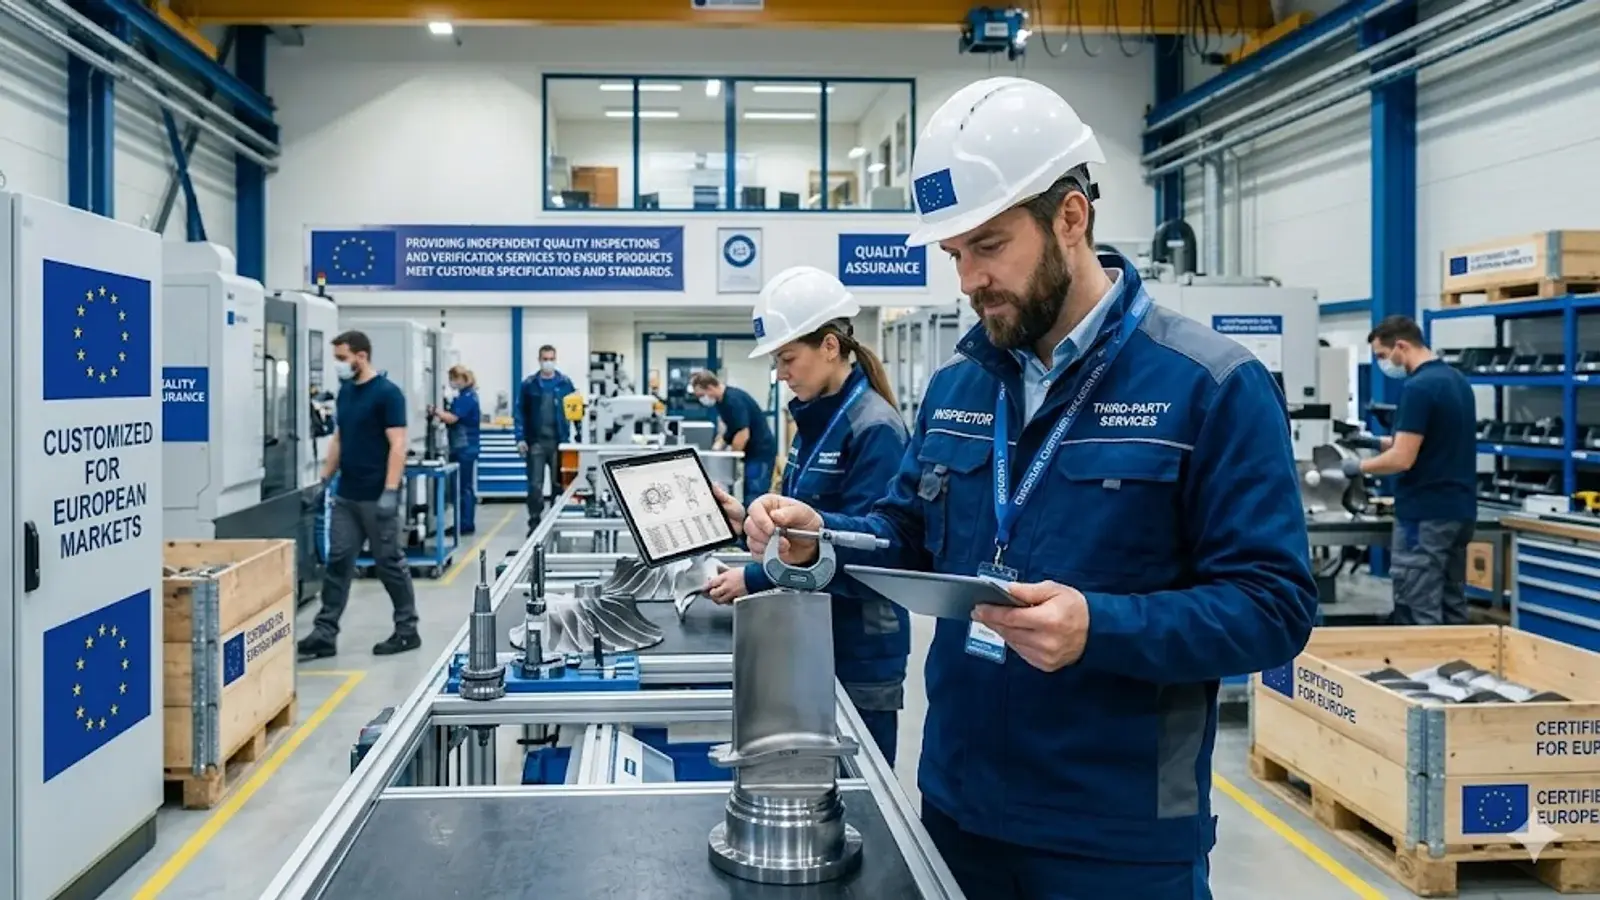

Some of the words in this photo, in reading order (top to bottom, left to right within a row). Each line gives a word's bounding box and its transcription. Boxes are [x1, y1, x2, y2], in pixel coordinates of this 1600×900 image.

[406, 237, 465, 249] PROVIDING
[467, 237, 540, 249] INDEPENDENT
[543, 237, 589, 250] QUALITY
[591, 237, 660, 249] INSPECTIONS
[406, 251, 429, 262] AND
[505, 251, 555, 263] SERVICES
[557, 252, 571, 263] TO
[573, 252, 614, 263] ENSURE
[616, 252, 673, 263] PRODUCTS
[855, 246, 910, 260] QUALITY
[406, 265, 434, 277] MEET
[436, 265, 494, 277] CUSTOMER
[497, 265, 581, 277] SPECIFICATIONS
[583, 266, 606, 277] AND
[608, 266, 674, 277] STANDARDS.
[845, 261, 920, 274] ASSURANCE
[161, 379, 196, 389] ALITY
[931, 408, 994, 426] INSPECTOR
[1099, 415, 1158, 427] SERVICES
[44, 421, 153, 456] CUSTOMIZED
[85, 456, 120, 485] FOR
[54, 483, 147, 526] EUROPEAN
[61, 515, 142, 559] MARKETS
[1298, 684, 1316, 704] FOR
[1318, 693, 1356, 724] EUROPE
[1536, 740, 1568, 756] FOR
[1536, 808, 1599, 825] EUROPE
